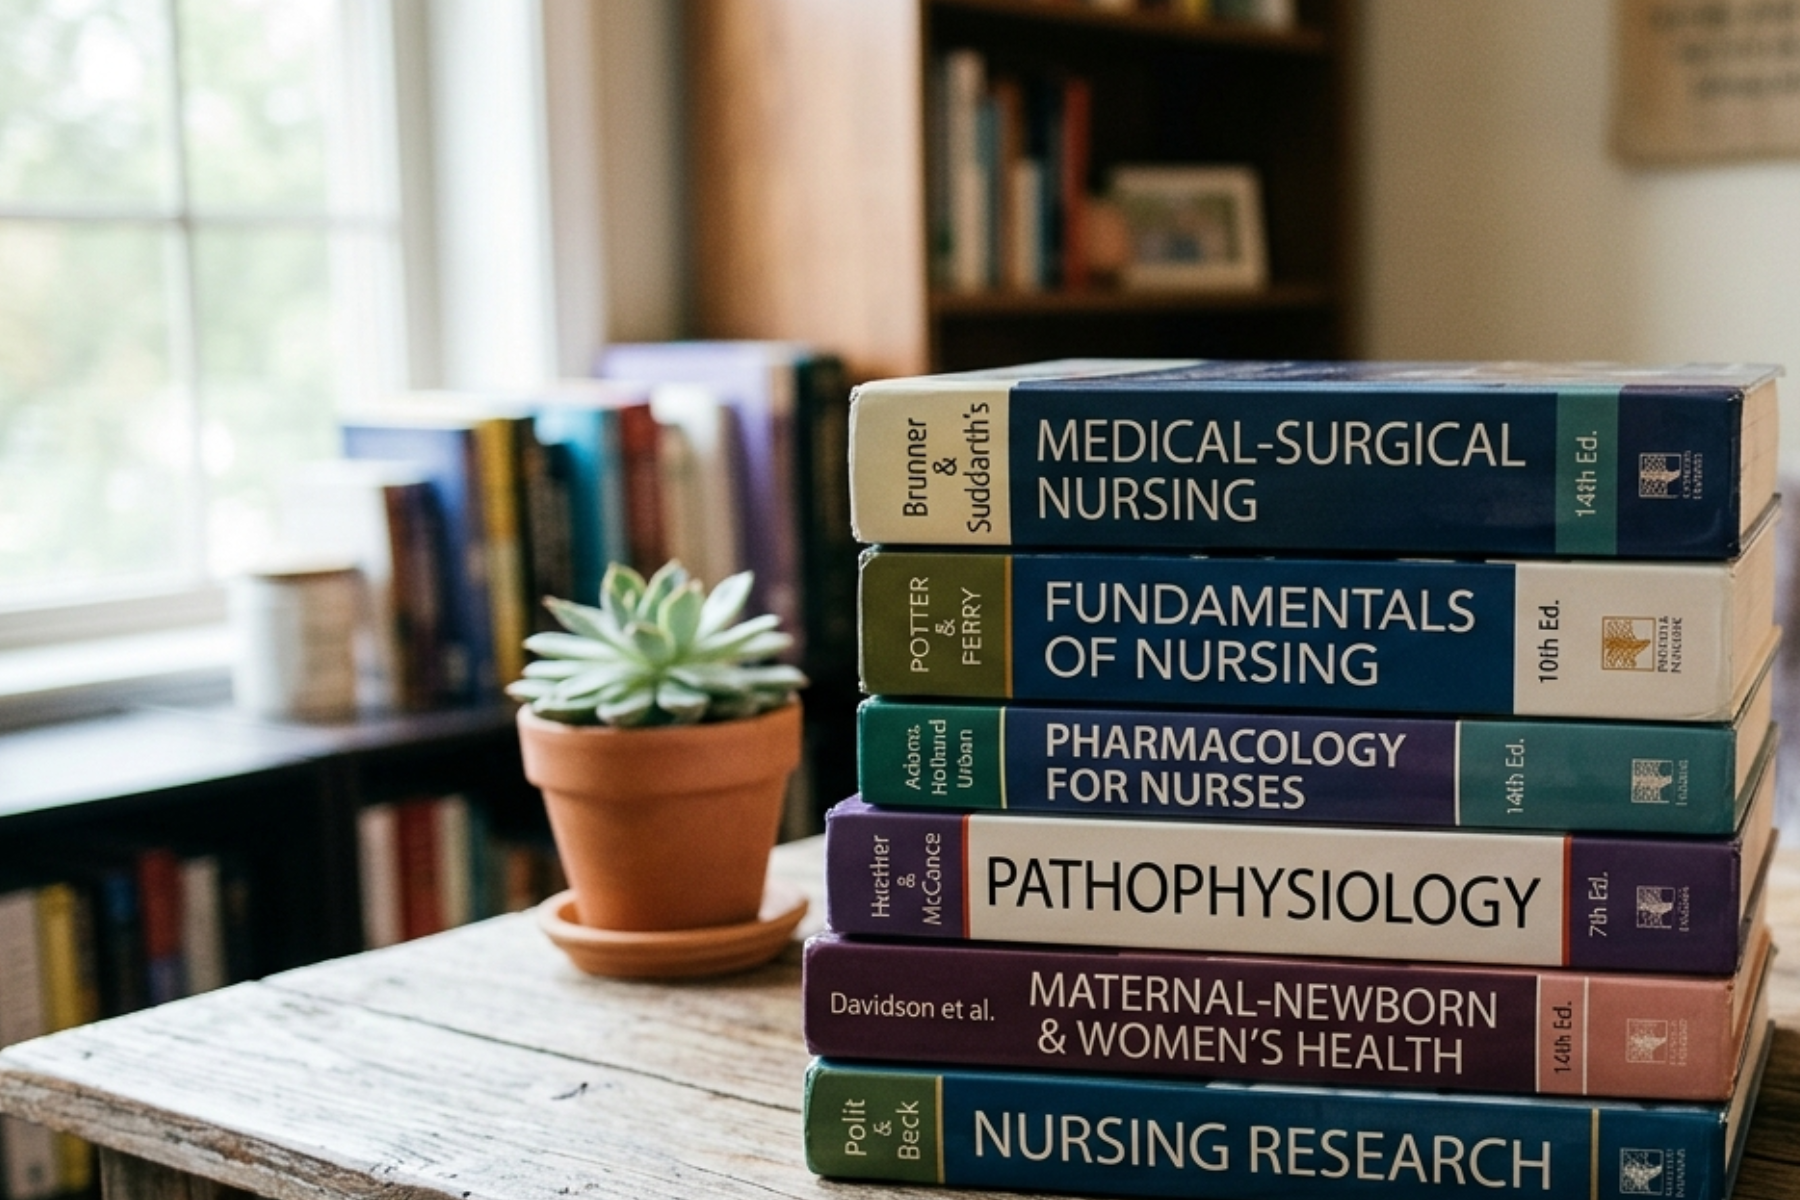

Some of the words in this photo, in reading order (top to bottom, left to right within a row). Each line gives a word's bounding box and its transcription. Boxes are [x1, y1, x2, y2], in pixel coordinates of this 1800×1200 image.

[902, 417, 929, 517] Brunner
[932, 457, 958, 477] &
[962, 402, 992, 533] Suddarth's
[1037, 419, 1526, 467] MEDICAL-SURGICAL
[1575, 430, 1598, 464] Ed.
[1038, 476, 1257, 522] NURSING
[909, 576, 930, 673] POTTER
[961, 587, 982, 665] FERRY
[1046, 581, 1475, 633] FUNDAMENTALS
[1538, 599, 1560, 631] Ed.
[1044, 635, 1118, 678] OF
[1137, 638, 1378, 686] NURSING
[1537, 638, 1560, 684] 10th
[1046, 723, 1407, 768] PHARMACOLOGY
[1505, 738, 1525, 768] Ed.
[1047, 767, 1129, 803] FOR
[1141, 770, 1305, 810] NURSES
[921, 832, 942, 925] McCance
[988, 856, 1541, 929] PATHOPHYSIOLOGY
[830, 991, 935, 1018] Davidson
[941, 1000, 964, 1020] et
[969, 998, 995, 1022] al.
[1029, 971, 1497, 1029] MATERNAL-NEWBORN
[1037, 1017, 1066, 1055] &
[1298, 1031, 1462, 1075] HEALTH
[841, 1098, 867, 1156] Polit
[895, 1100, 921, 1160] Beck
[975, 1110, 1229, 1171] NURSING
[1250, 1125, 1551, 1190] RESEARCH
